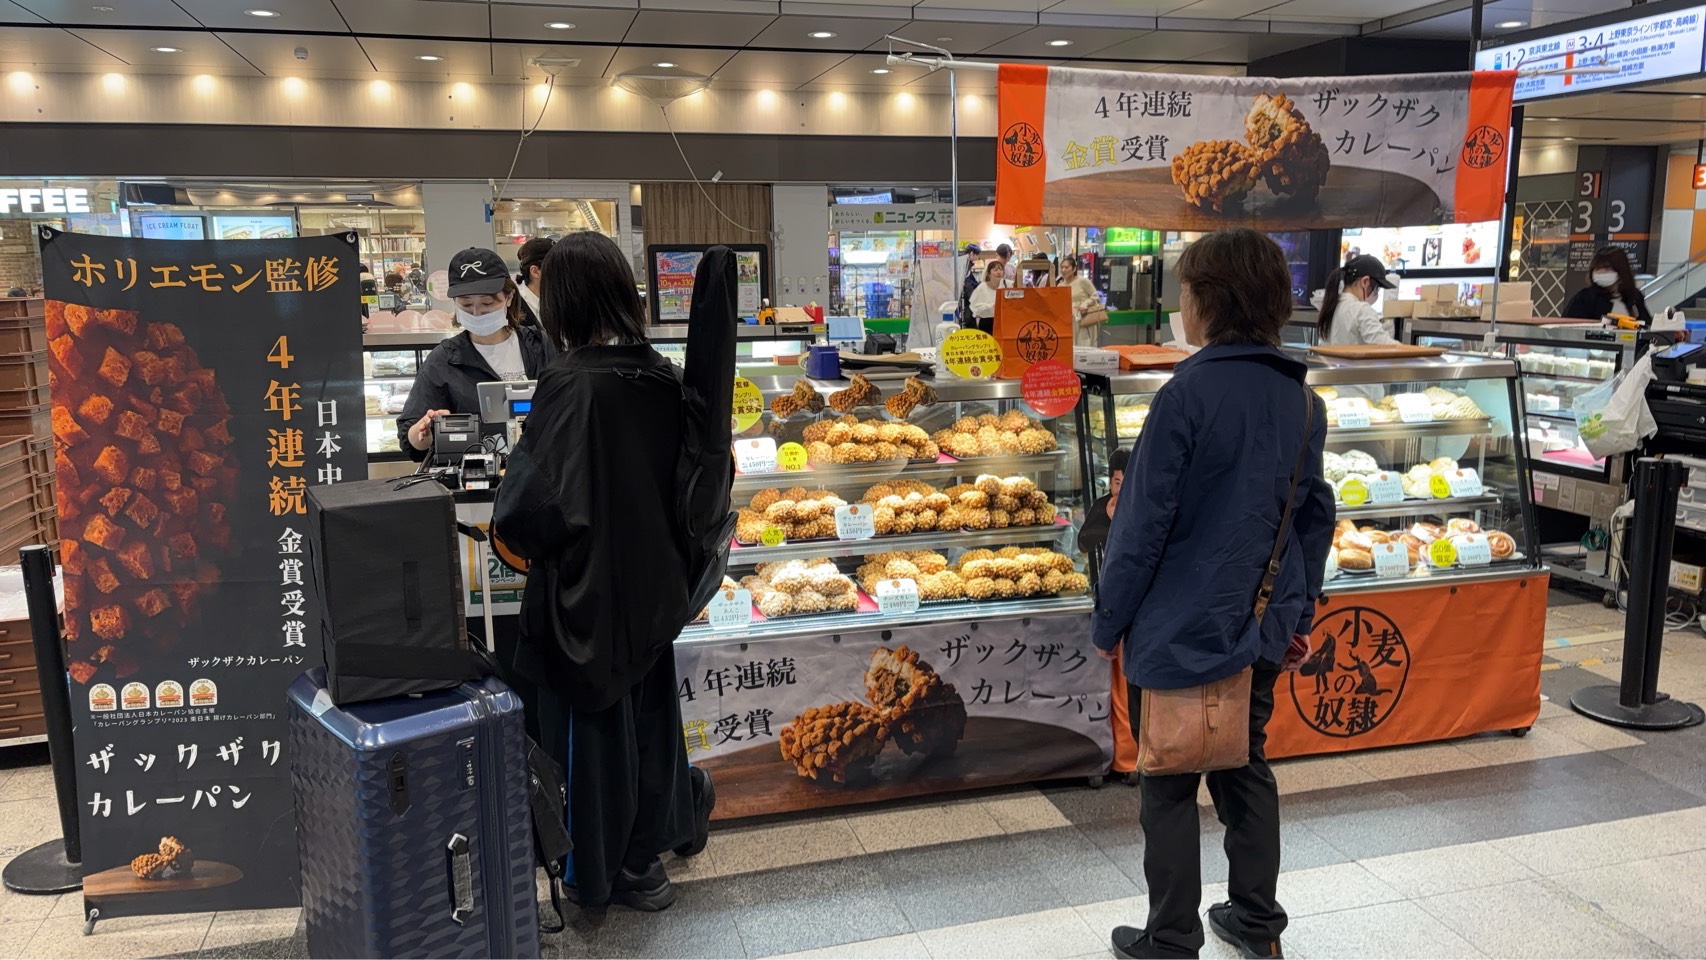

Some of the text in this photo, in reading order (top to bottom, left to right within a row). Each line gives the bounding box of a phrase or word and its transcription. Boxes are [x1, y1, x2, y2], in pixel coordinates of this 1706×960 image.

[1528, 41, 1561, 55] 京浜東北線
[1094, 90, 1193, 119] 4年連続
[1312, 87, 1440, 128] ザックザク
[1060, 134, 1170, 171] 金賞受賞
[1333, 129, 1455, 174] カレーパン
[0, 188, 90, 213] FFEE
[1581, 173, 1593, 195] 3
[146, 221, 199, 230] ICE CREAM FLOAT
[885, 211, 937, 223] ニュータス
[1575, 201, 1593, 233] 3
[1608, 200, 1626, 232] 3
[70, 253, 340, 293] ホリエモン監修
[945, 355, 1001, 365] 4年連続金賞受賞
[263, 335, 308, 516] 4年連続
[1435, 555, 1451, 563] 限定
[276, 527, 307, 648] 金賞受賞
[187, 655, 305, 668] ザックザクカレーパン
[939, 634, 1087, 674] ザックザク
[1313, 609, 1403, 732] 小麦の奴隷
[679, 657, 797, 702] 4年連続
[969, 678, 1110, 722] カレーパン
[86, 737, 281, 774] ザックザク
[88, 785, 251, 818] カレーパン
